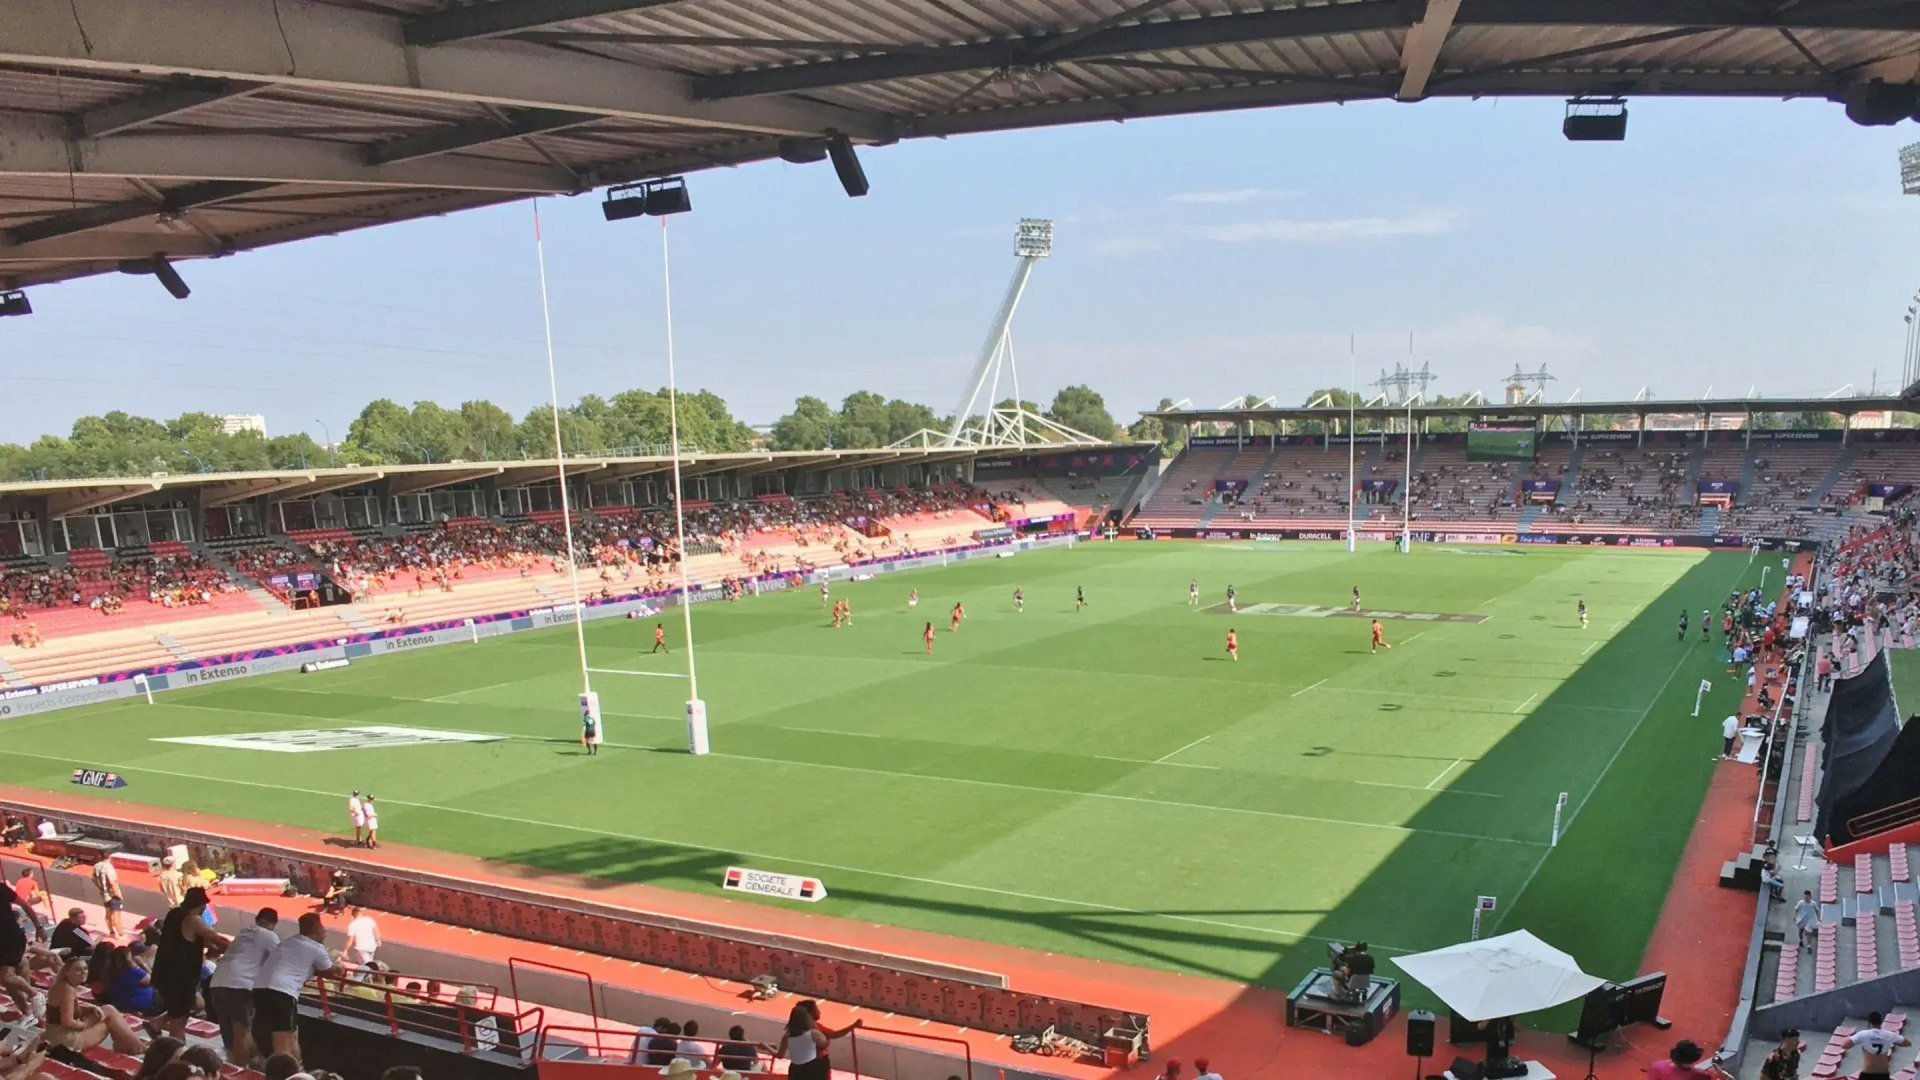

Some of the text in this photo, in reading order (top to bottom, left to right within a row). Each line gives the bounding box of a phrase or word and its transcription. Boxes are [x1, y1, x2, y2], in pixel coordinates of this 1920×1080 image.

[1298, 532, 1333, 540] DURACELL
[396, 634, 435, 649] Extenso
[186, 671, 199, 683] In
[200, 664, 248, 681] Extenso
[82, 770, 106, 787] GMF
[745, 881, 793, 896] GENERALE
[1872, 1043, 1883, 1055] 7
